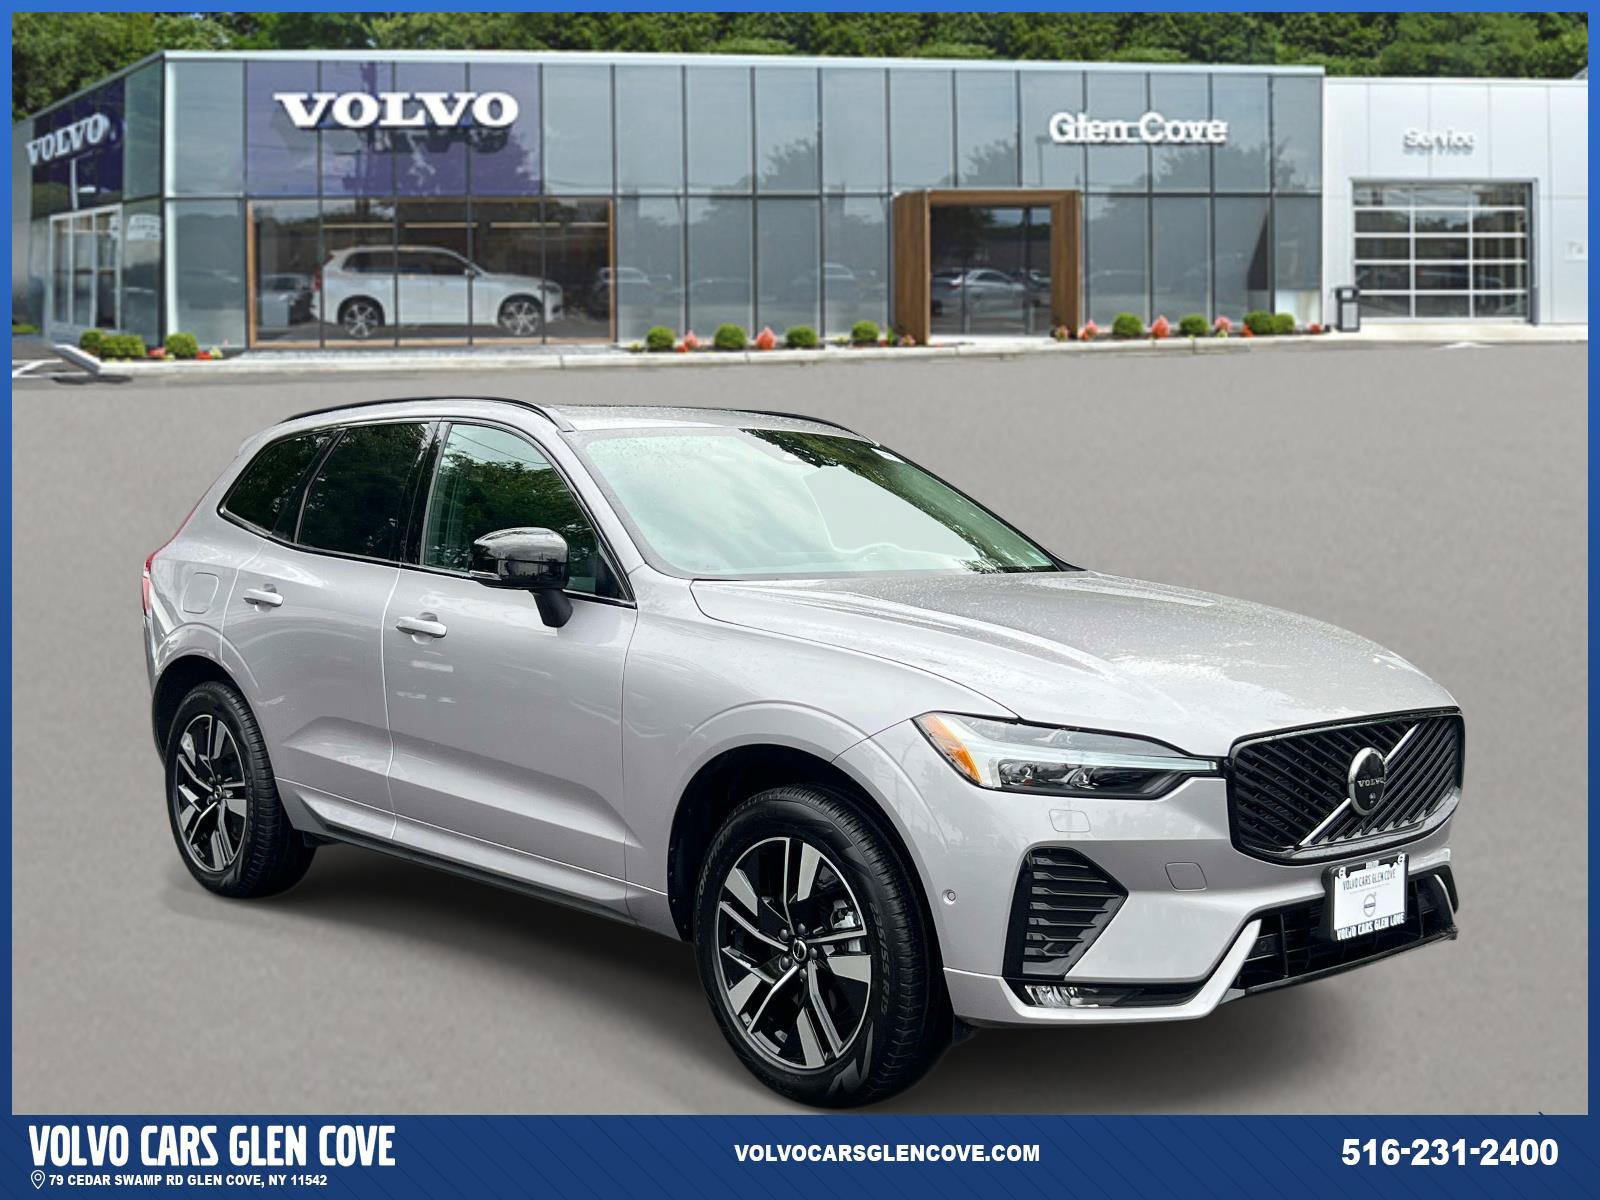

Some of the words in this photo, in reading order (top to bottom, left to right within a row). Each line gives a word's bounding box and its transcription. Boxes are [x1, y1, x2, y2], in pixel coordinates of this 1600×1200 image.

[273, 91, 519, 128] VOLVO
[1049, 112, 1129, 143] Glen
[1139, 112, 1228, 143] Cove
[25, 113, 111, 166] VOLVO
